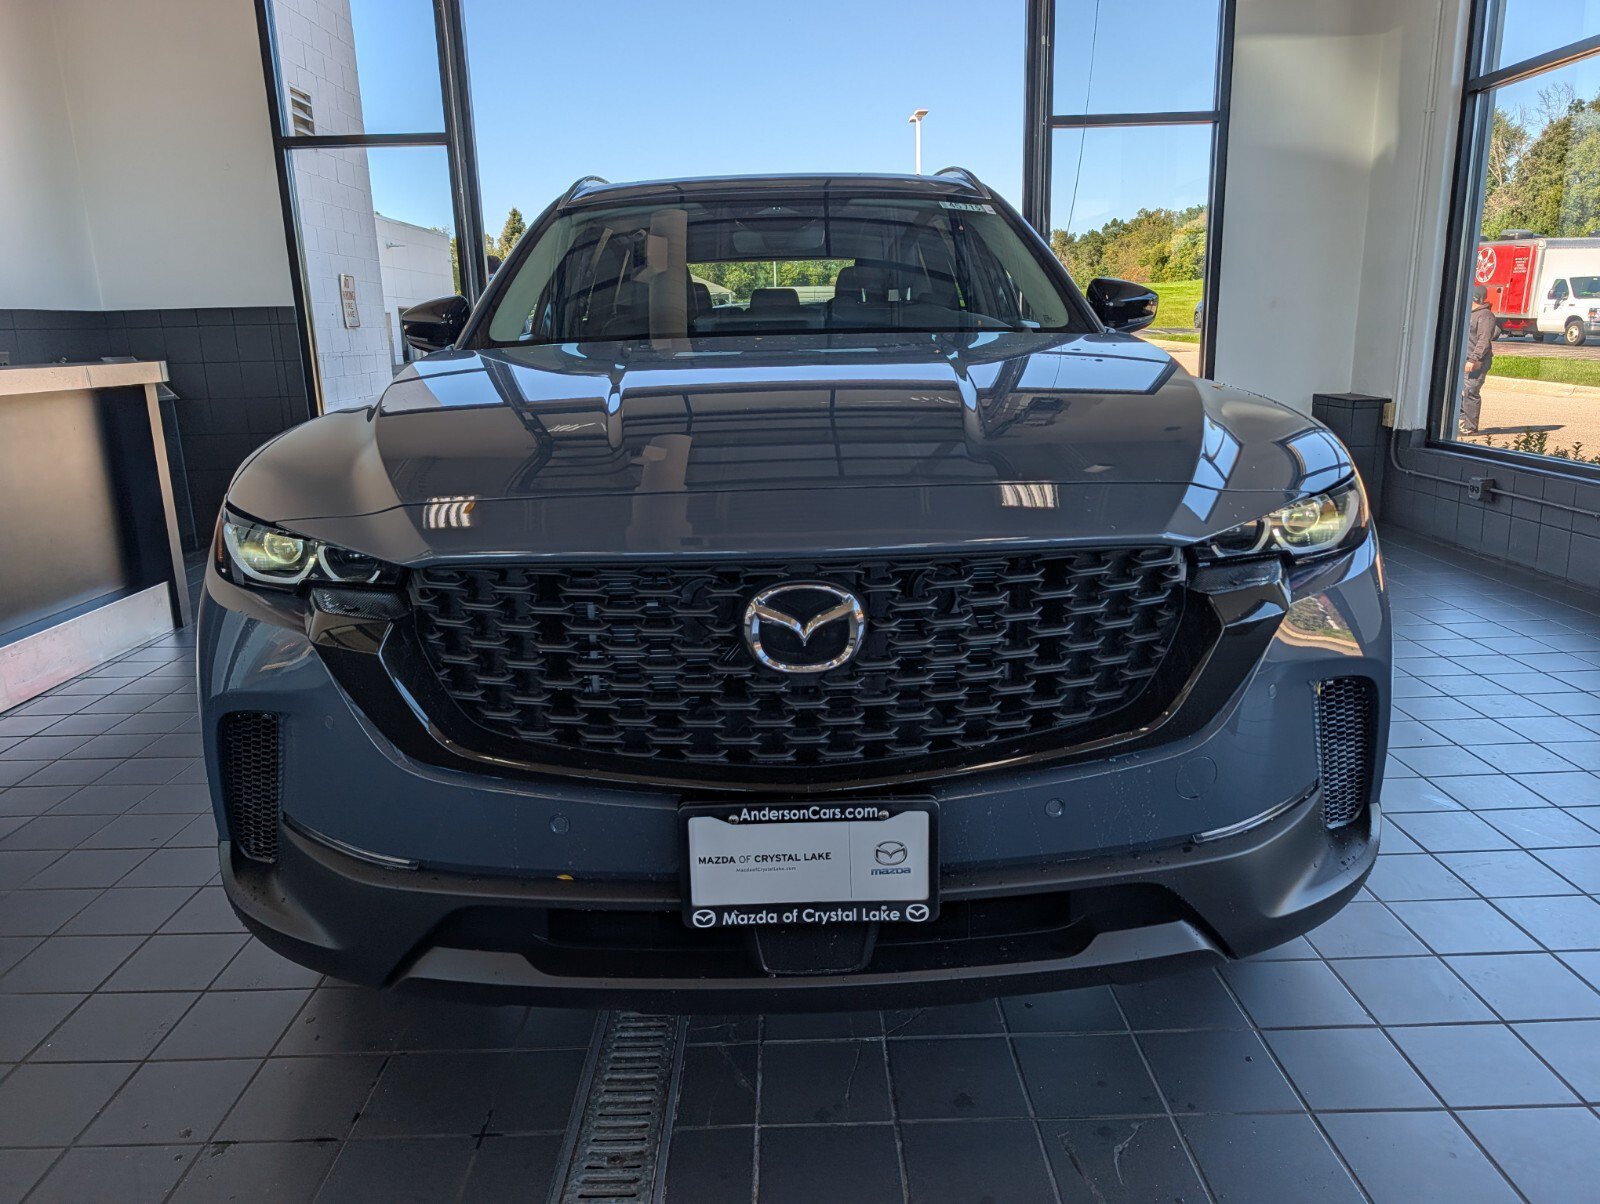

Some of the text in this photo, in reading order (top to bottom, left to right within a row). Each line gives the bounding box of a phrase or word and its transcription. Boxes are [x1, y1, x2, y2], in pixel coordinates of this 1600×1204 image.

[740, 806, 878, 822] AndersonCars.com
[698, 851, 832, 865] MAZDA OF CRYSTAL LAKE
[870, 867, 911, 875] mazda
[722, 907, 900, 926] Mazda of Crystal Lake
